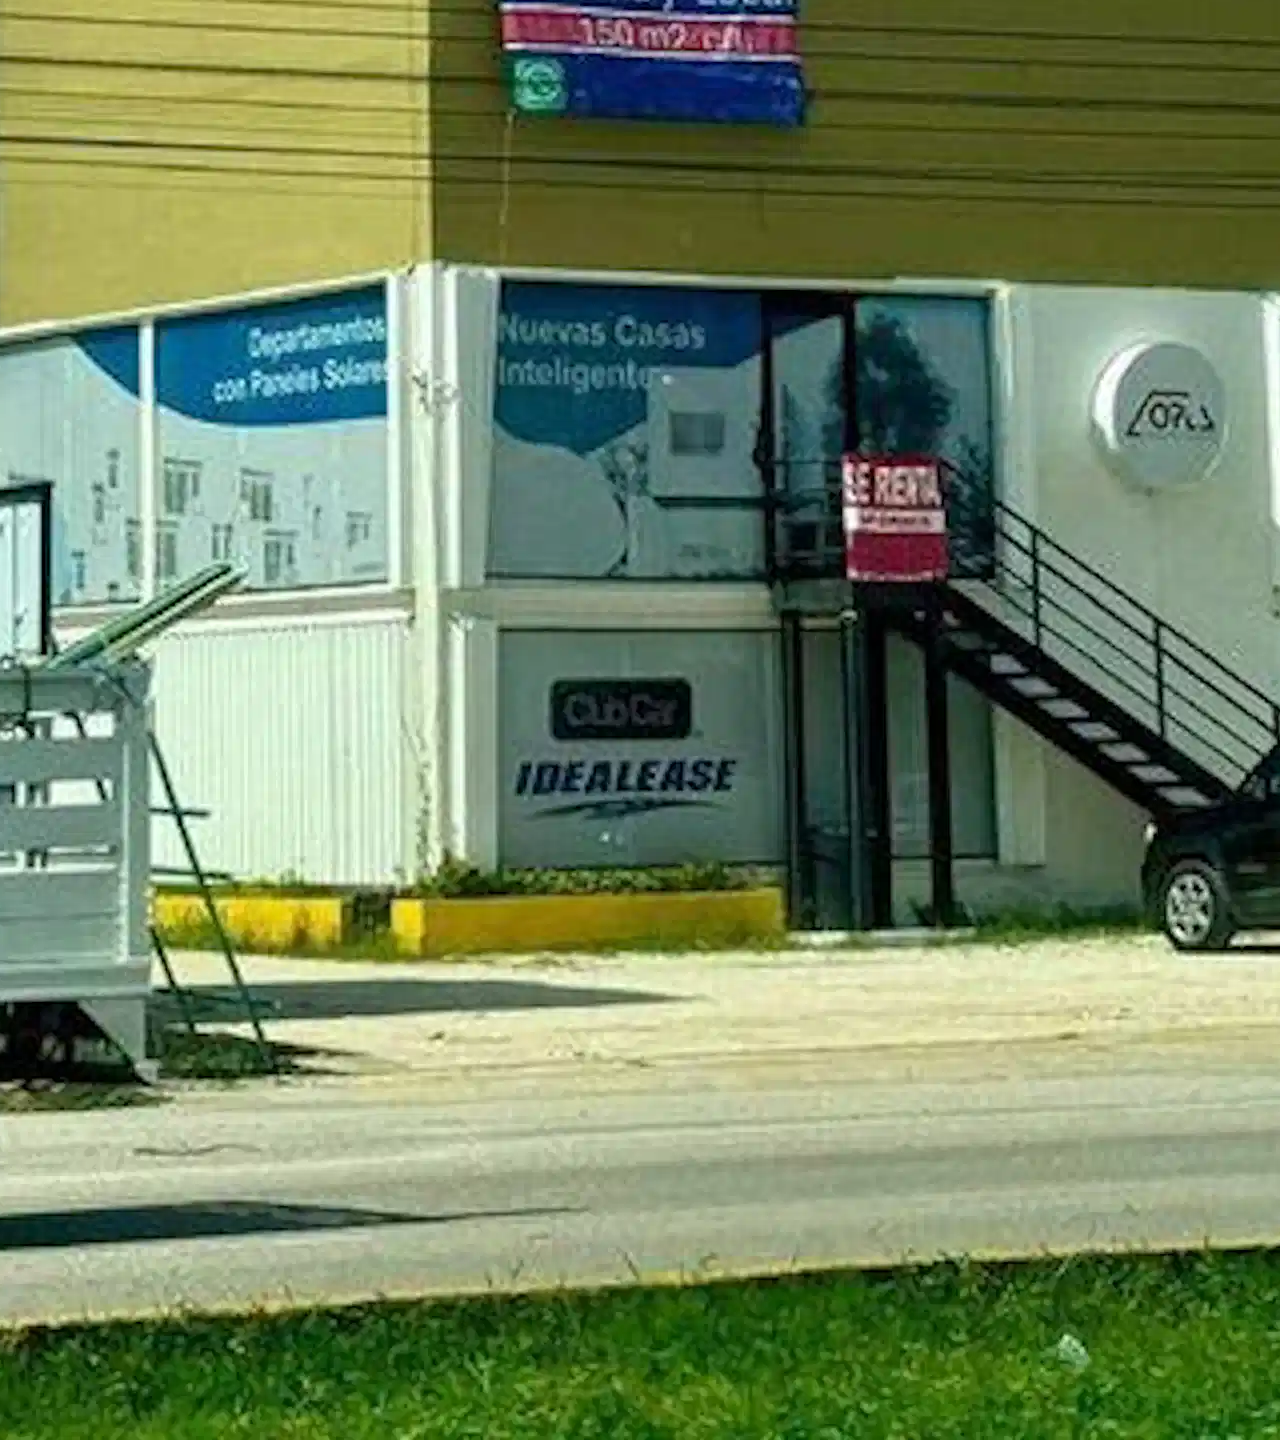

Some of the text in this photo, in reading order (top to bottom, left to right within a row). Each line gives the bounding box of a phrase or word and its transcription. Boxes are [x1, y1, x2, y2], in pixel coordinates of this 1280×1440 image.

[577, 17, 635, 47] 150
[498, 311, 706, 350] Nuevas Casas
[514, 759, 737, 796] IDEALEASE
